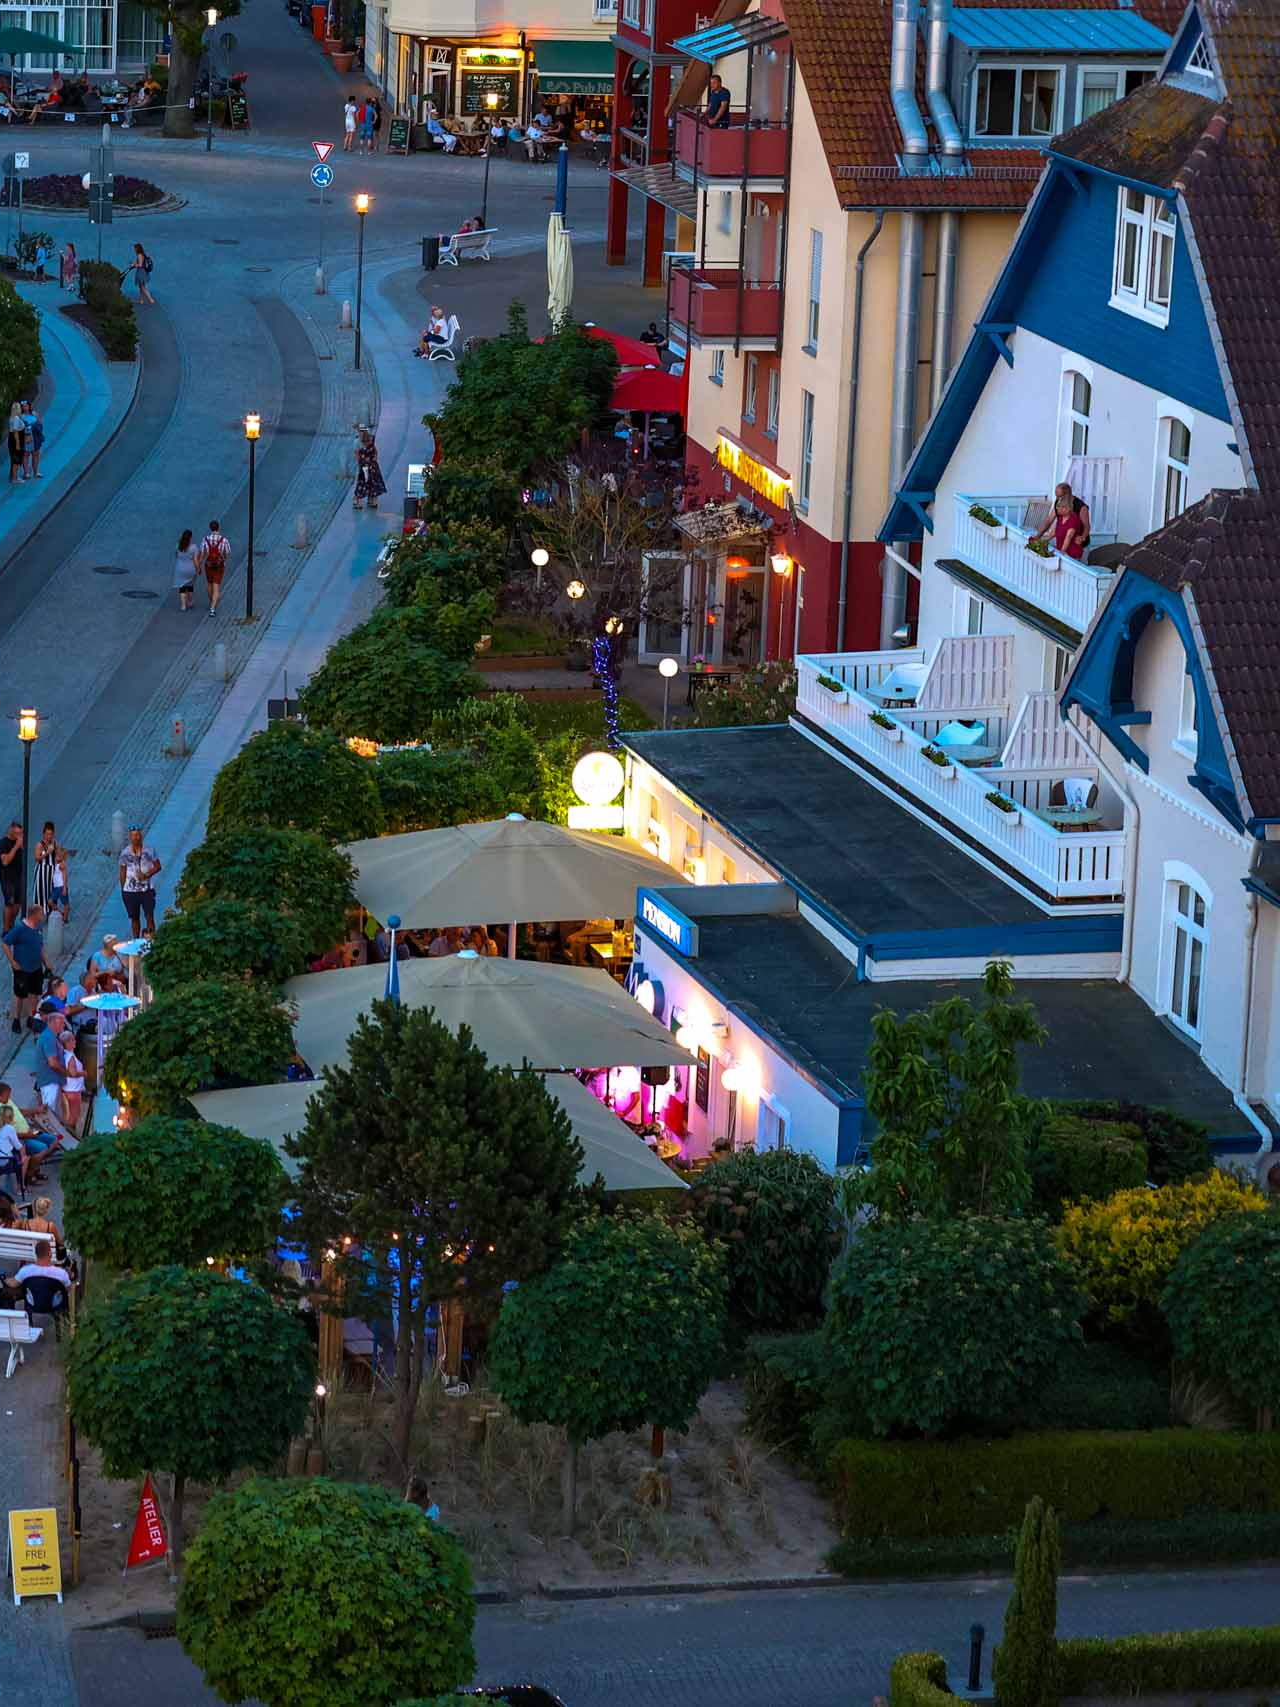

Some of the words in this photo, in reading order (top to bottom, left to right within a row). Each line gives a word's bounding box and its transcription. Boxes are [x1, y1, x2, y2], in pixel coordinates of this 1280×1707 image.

[574, 81, 595, 93] Pub
[642, 896, 681, 945] PENSION
[142, 1498, 162, 1546] ATELIER
[25, 1549, 47, 1560] FREI
